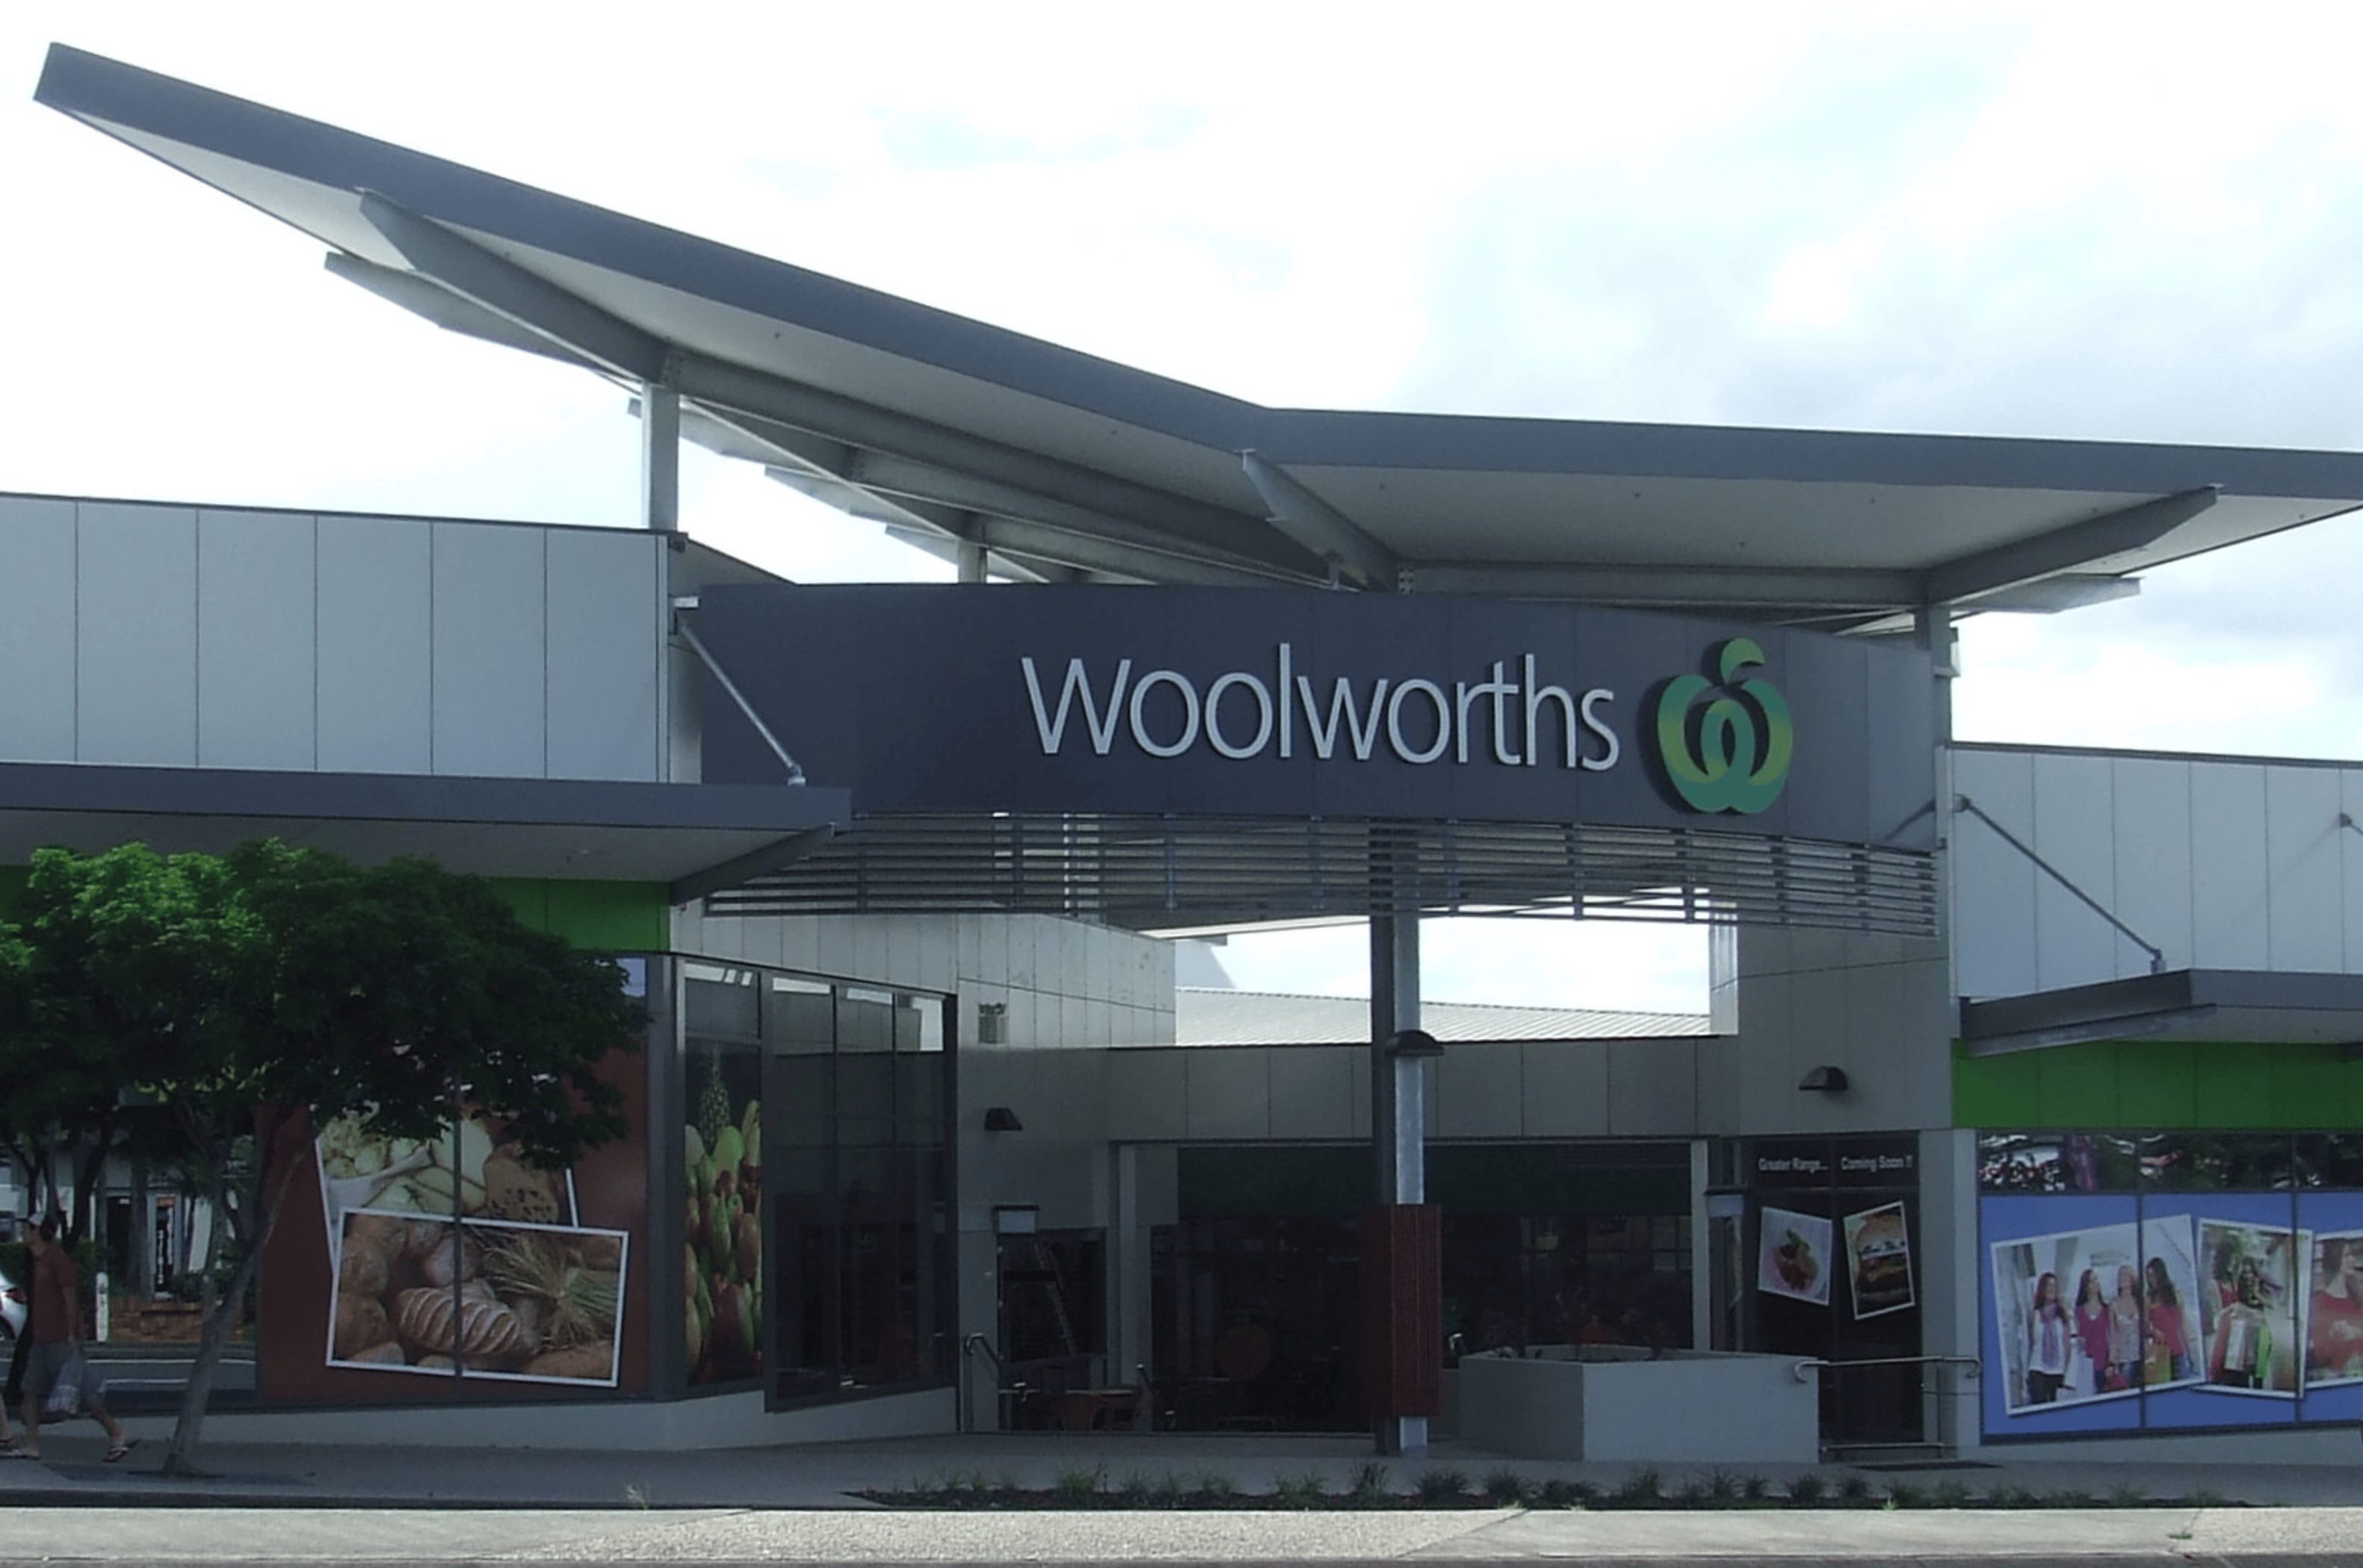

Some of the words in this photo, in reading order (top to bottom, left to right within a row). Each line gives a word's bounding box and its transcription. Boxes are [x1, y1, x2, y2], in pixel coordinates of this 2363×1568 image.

[1021, 642, 1620, 771] Woolworths
[1758, 1158, 1791, 1170] Greater
[1841, 1156, 1876, 1173] Coming
[1878, 1155, 1903, 1169] Soon
